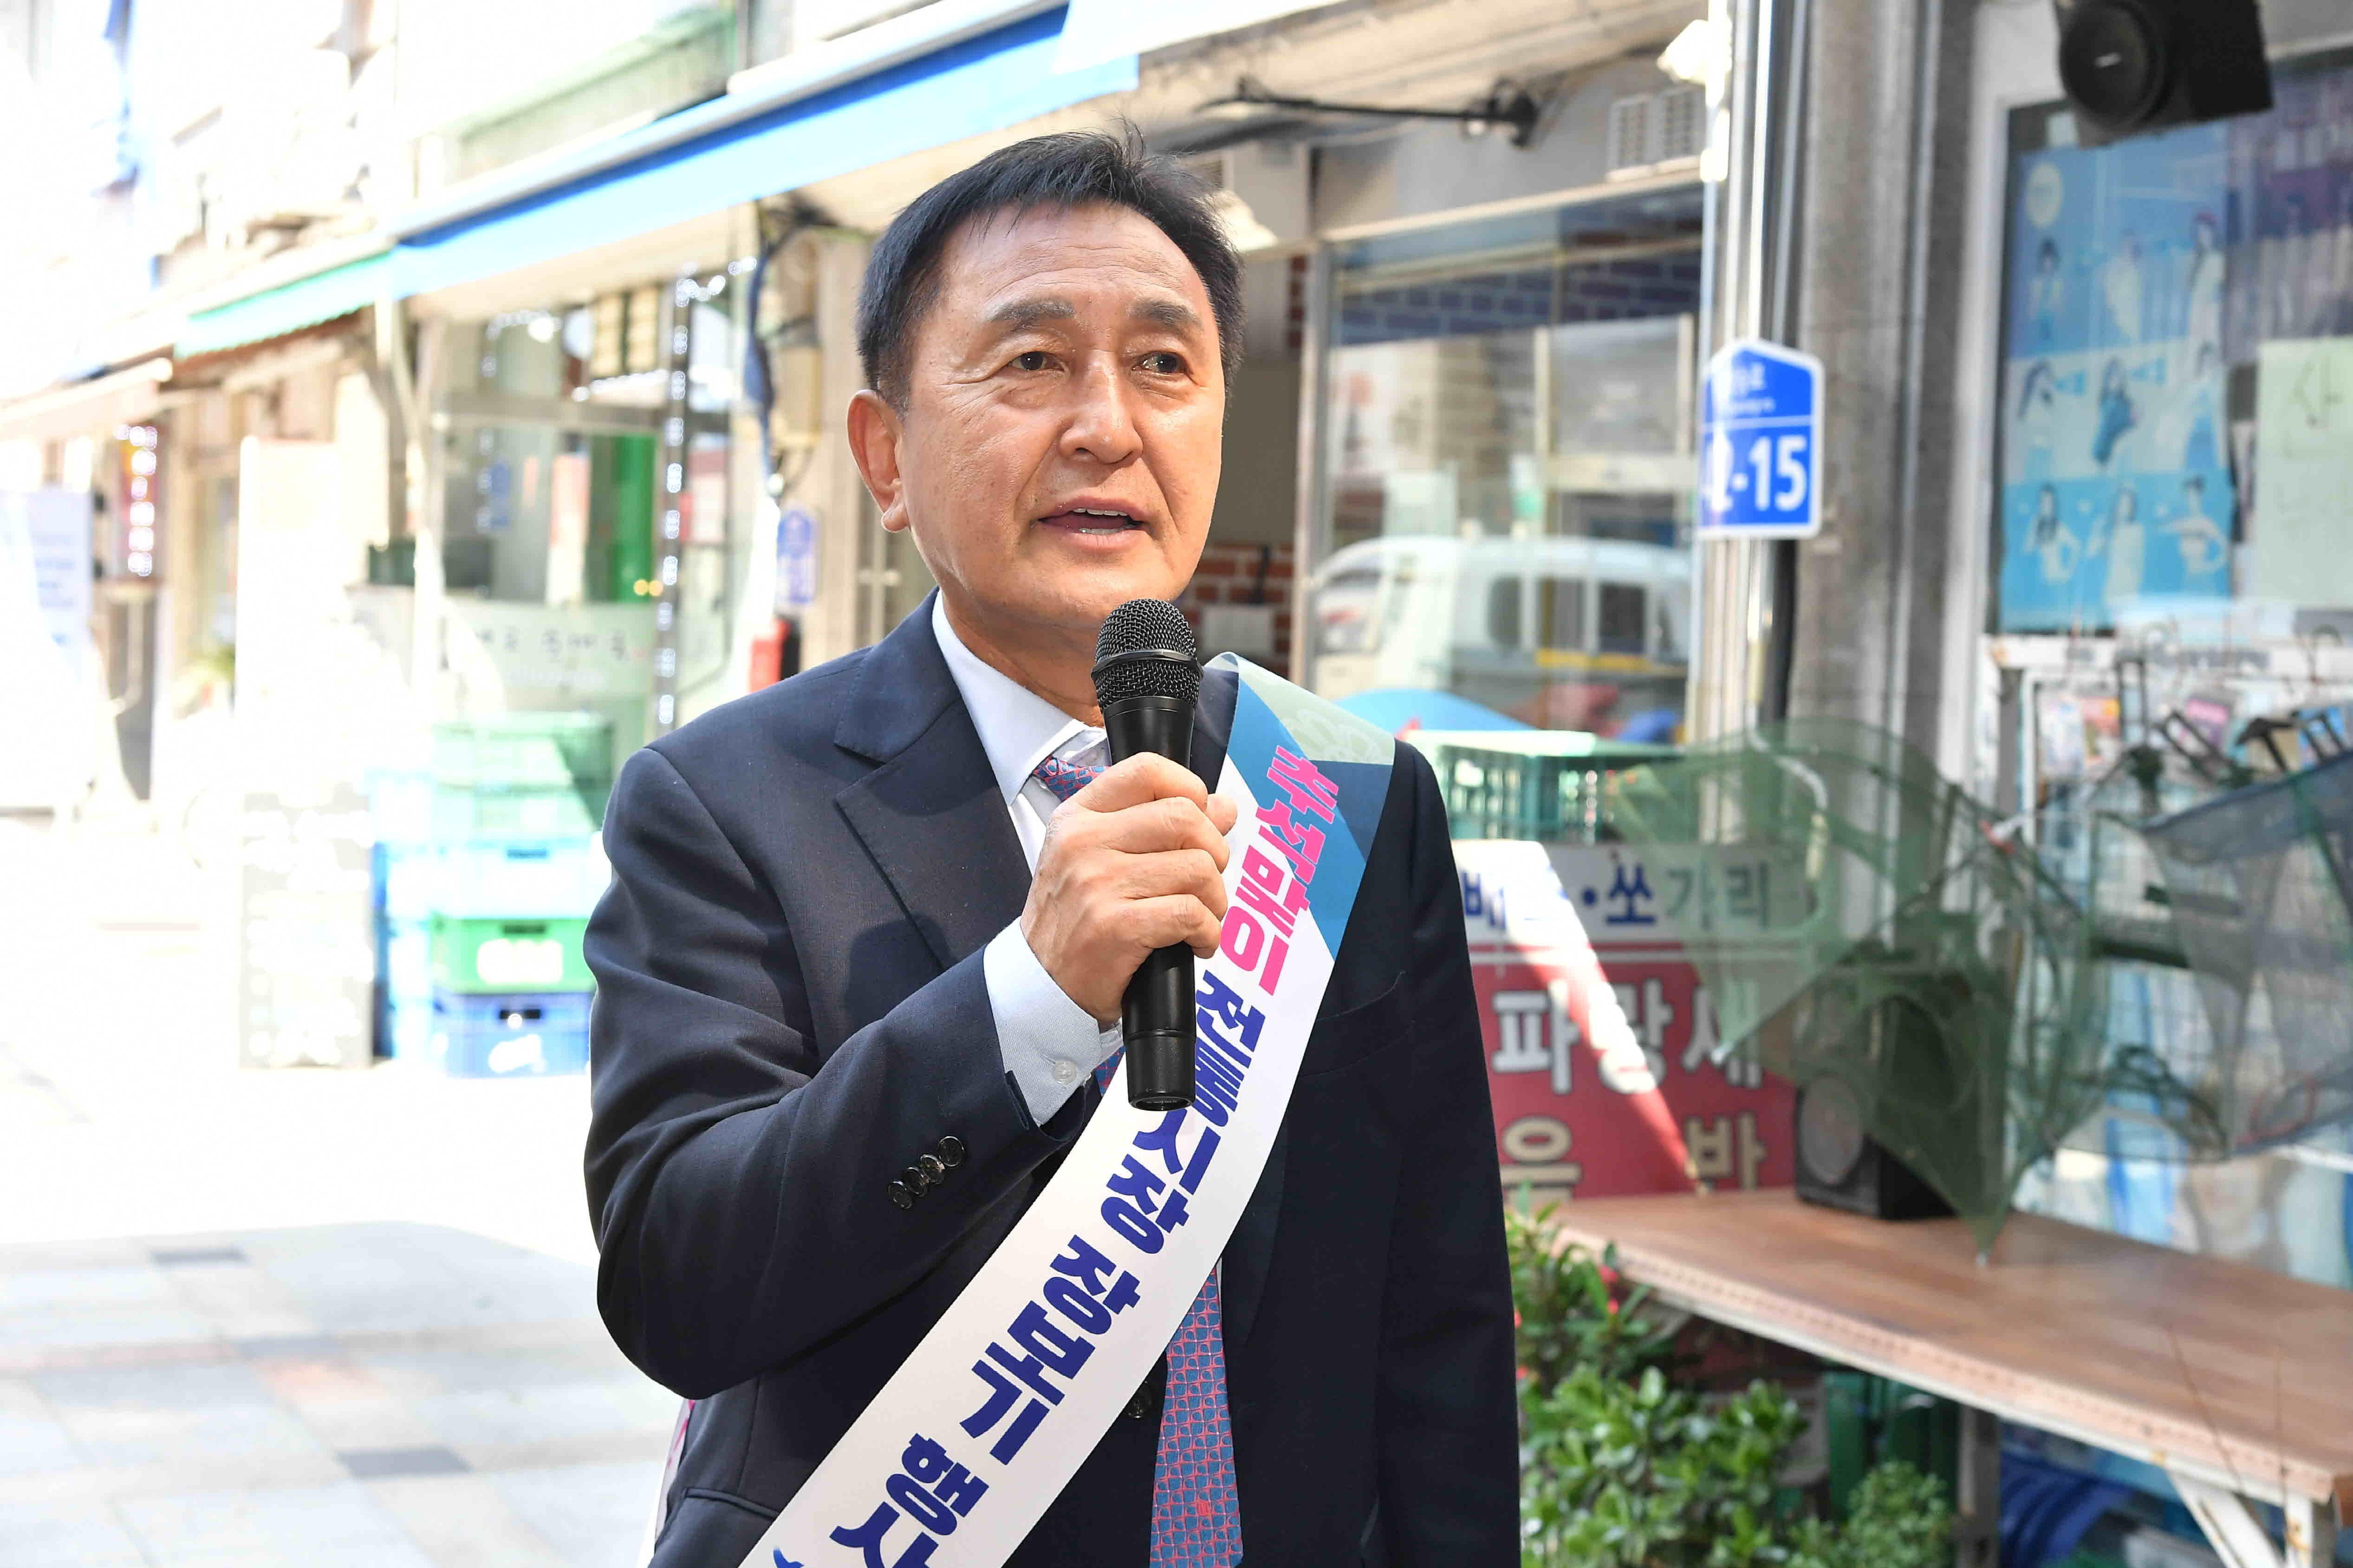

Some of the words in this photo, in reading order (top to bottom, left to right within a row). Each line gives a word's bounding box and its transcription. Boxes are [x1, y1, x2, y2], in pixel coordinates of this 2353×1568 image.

[1219, 744, 1339, 997] 추석맞이
[1102, 970, 1266, 1254] 전통시장
[961, 1234, 1140, 1465] 장보기
